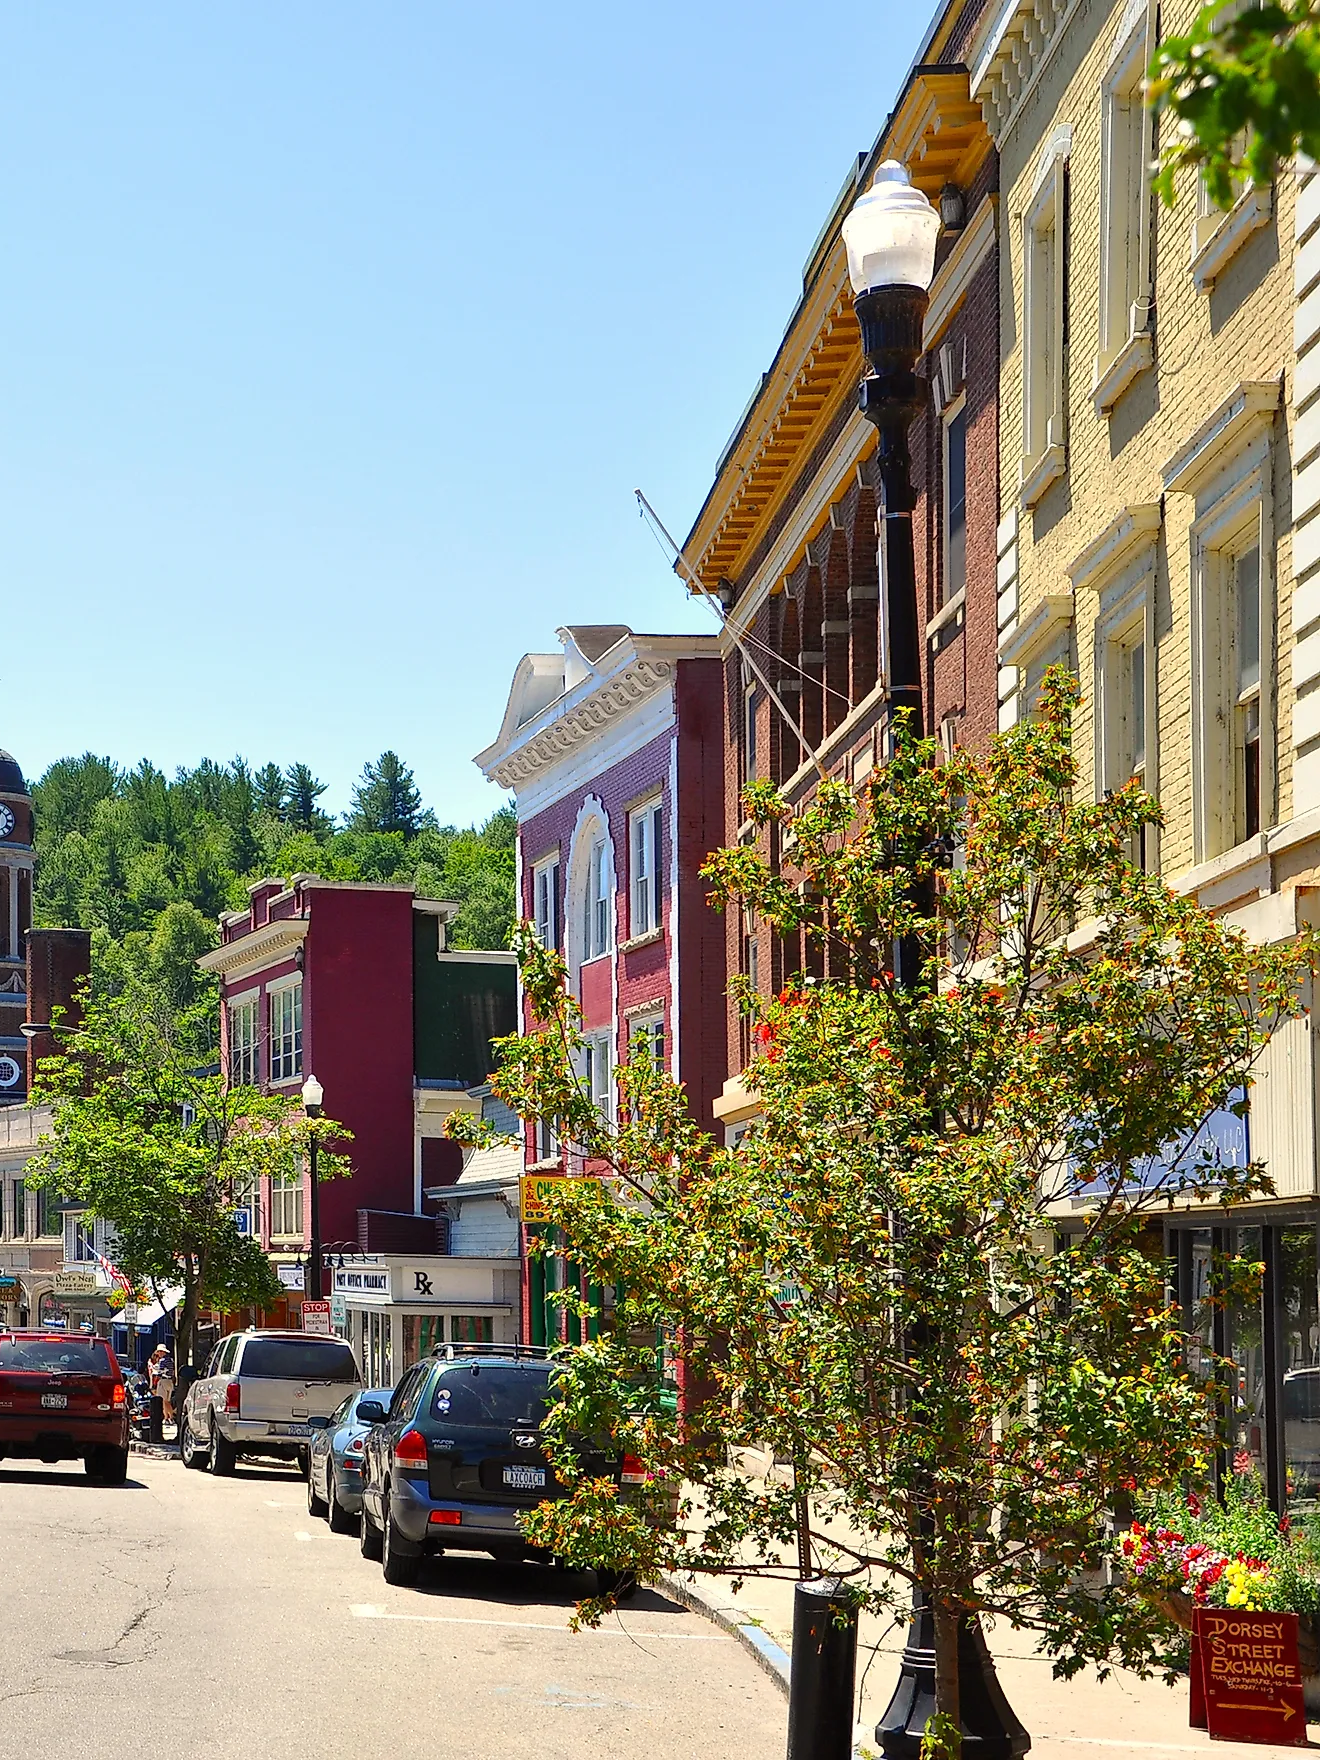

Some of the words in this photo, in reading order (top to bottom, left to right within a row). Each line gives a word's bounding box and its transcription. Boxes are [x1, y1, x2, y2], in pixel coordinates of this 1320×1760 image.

[55, 1273, 76, 1283] Owl's
[78, 1275, 94, 1284] Nest
[303, 1303, 328, 1312] STOP
[504, 1471, 544, 1485] LAXCOACH
[1205, 1617, 1284, 1640] DORSEY
[1211, 1636, 1285, 1659] STREET
[1210, 1656, 1296, 1678] EXCHANGE
